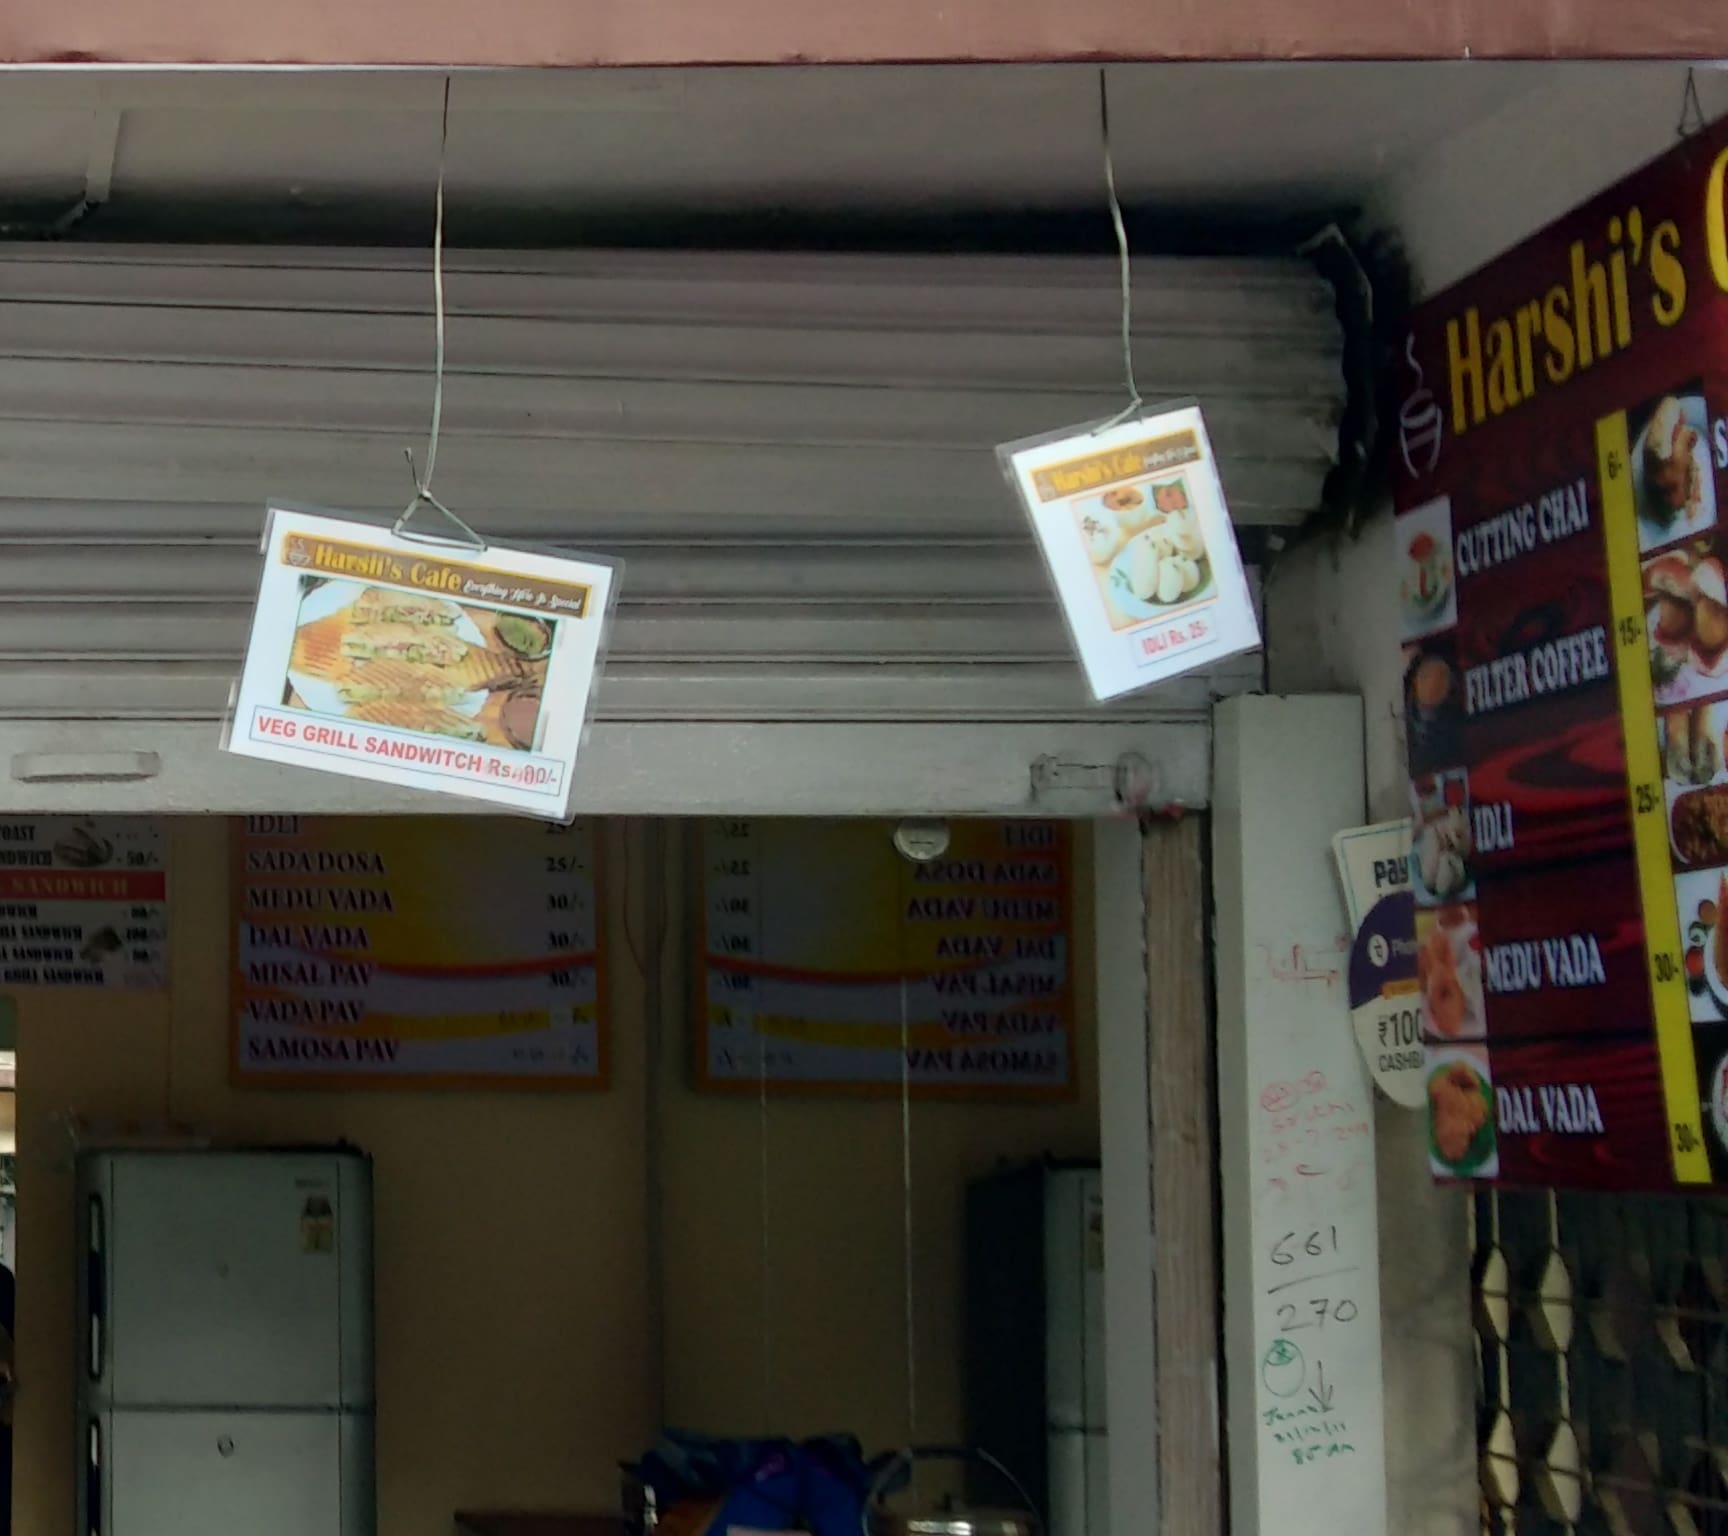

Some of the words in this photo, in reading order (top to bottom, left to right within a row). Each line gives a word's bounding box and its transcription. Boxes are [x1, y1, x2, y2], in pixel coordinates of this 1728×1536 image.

[1445, 206, 1688, 436] Harshi's
[1456, 500, 1537, 577] CUTTING
[1538, 478, 1590, 544] CHAI
[314, 543, 403, 582] Harshi's
[409, 562, 463, 591] Cafe
[1465, 652, 1530, 716] FILTER
[1530, 626, 1610, 700] COFFEE
[257, 714, 297, 739] VEG
[302, 723, 359, 751] GRILL
[363, 735, 482, 774] SANDWITCH
[1473, 800, 1516, 854] IDLI
[248, 852, 309, 874] SADA
[315, 853, 385, 874] DOSA
[248, 889, 325, 911] MEDU
[328, 890, 394, 912] VADA
[303, 927, 369, 949] VADA
[1482, 940, 1543, 995] MEDU
[1542, 931, 1608, 986] VADA
[329, 964, 373, 986] PAV
[247, 1000, 318, 1022] VADA
[319, 1001, 364, 1023] PAV
[248, 1038, 353, 1061] SAMOSA
[355, 1039, 400, 1062] PAV
[1495, 1084, 1540, 1135] DAL
[1540, 1083, 1606, 1135] VADA
